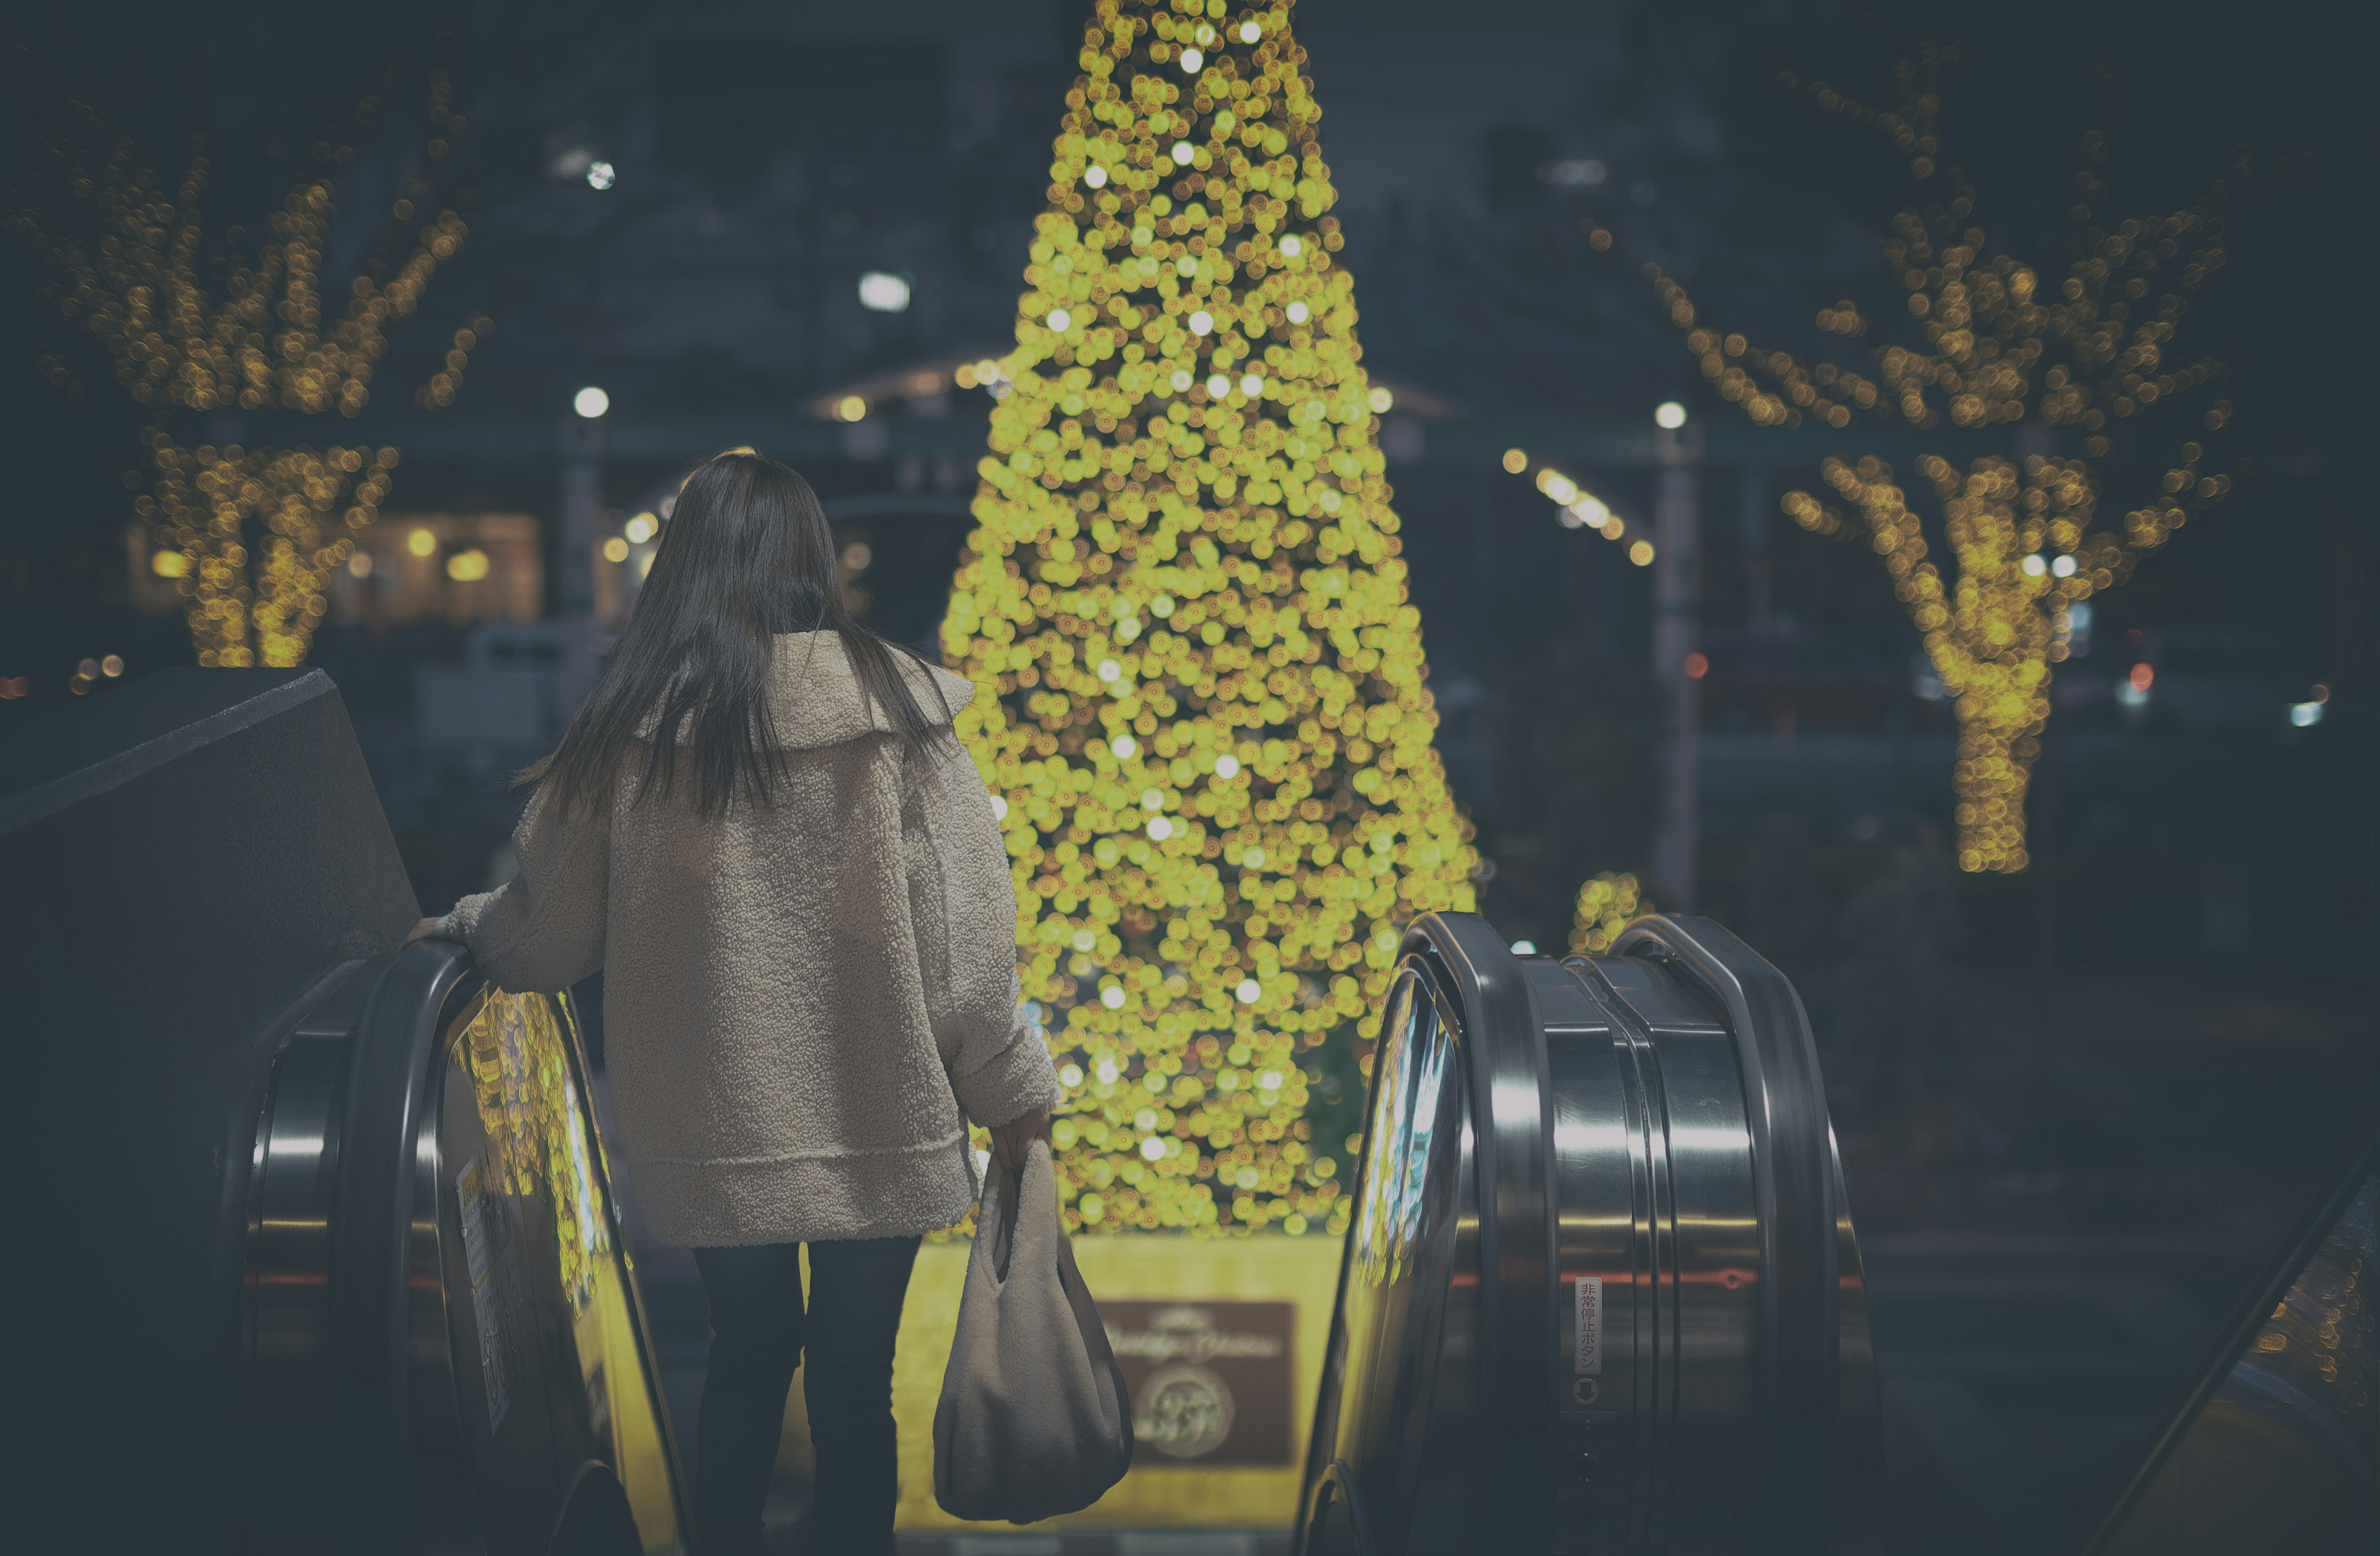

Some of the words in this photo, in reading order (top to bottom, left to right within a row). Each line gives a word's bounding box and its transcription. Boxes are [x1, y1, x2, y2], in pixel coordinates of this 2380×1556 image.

[1581, 1283, 1595, 1368] 非常停止ボタン
